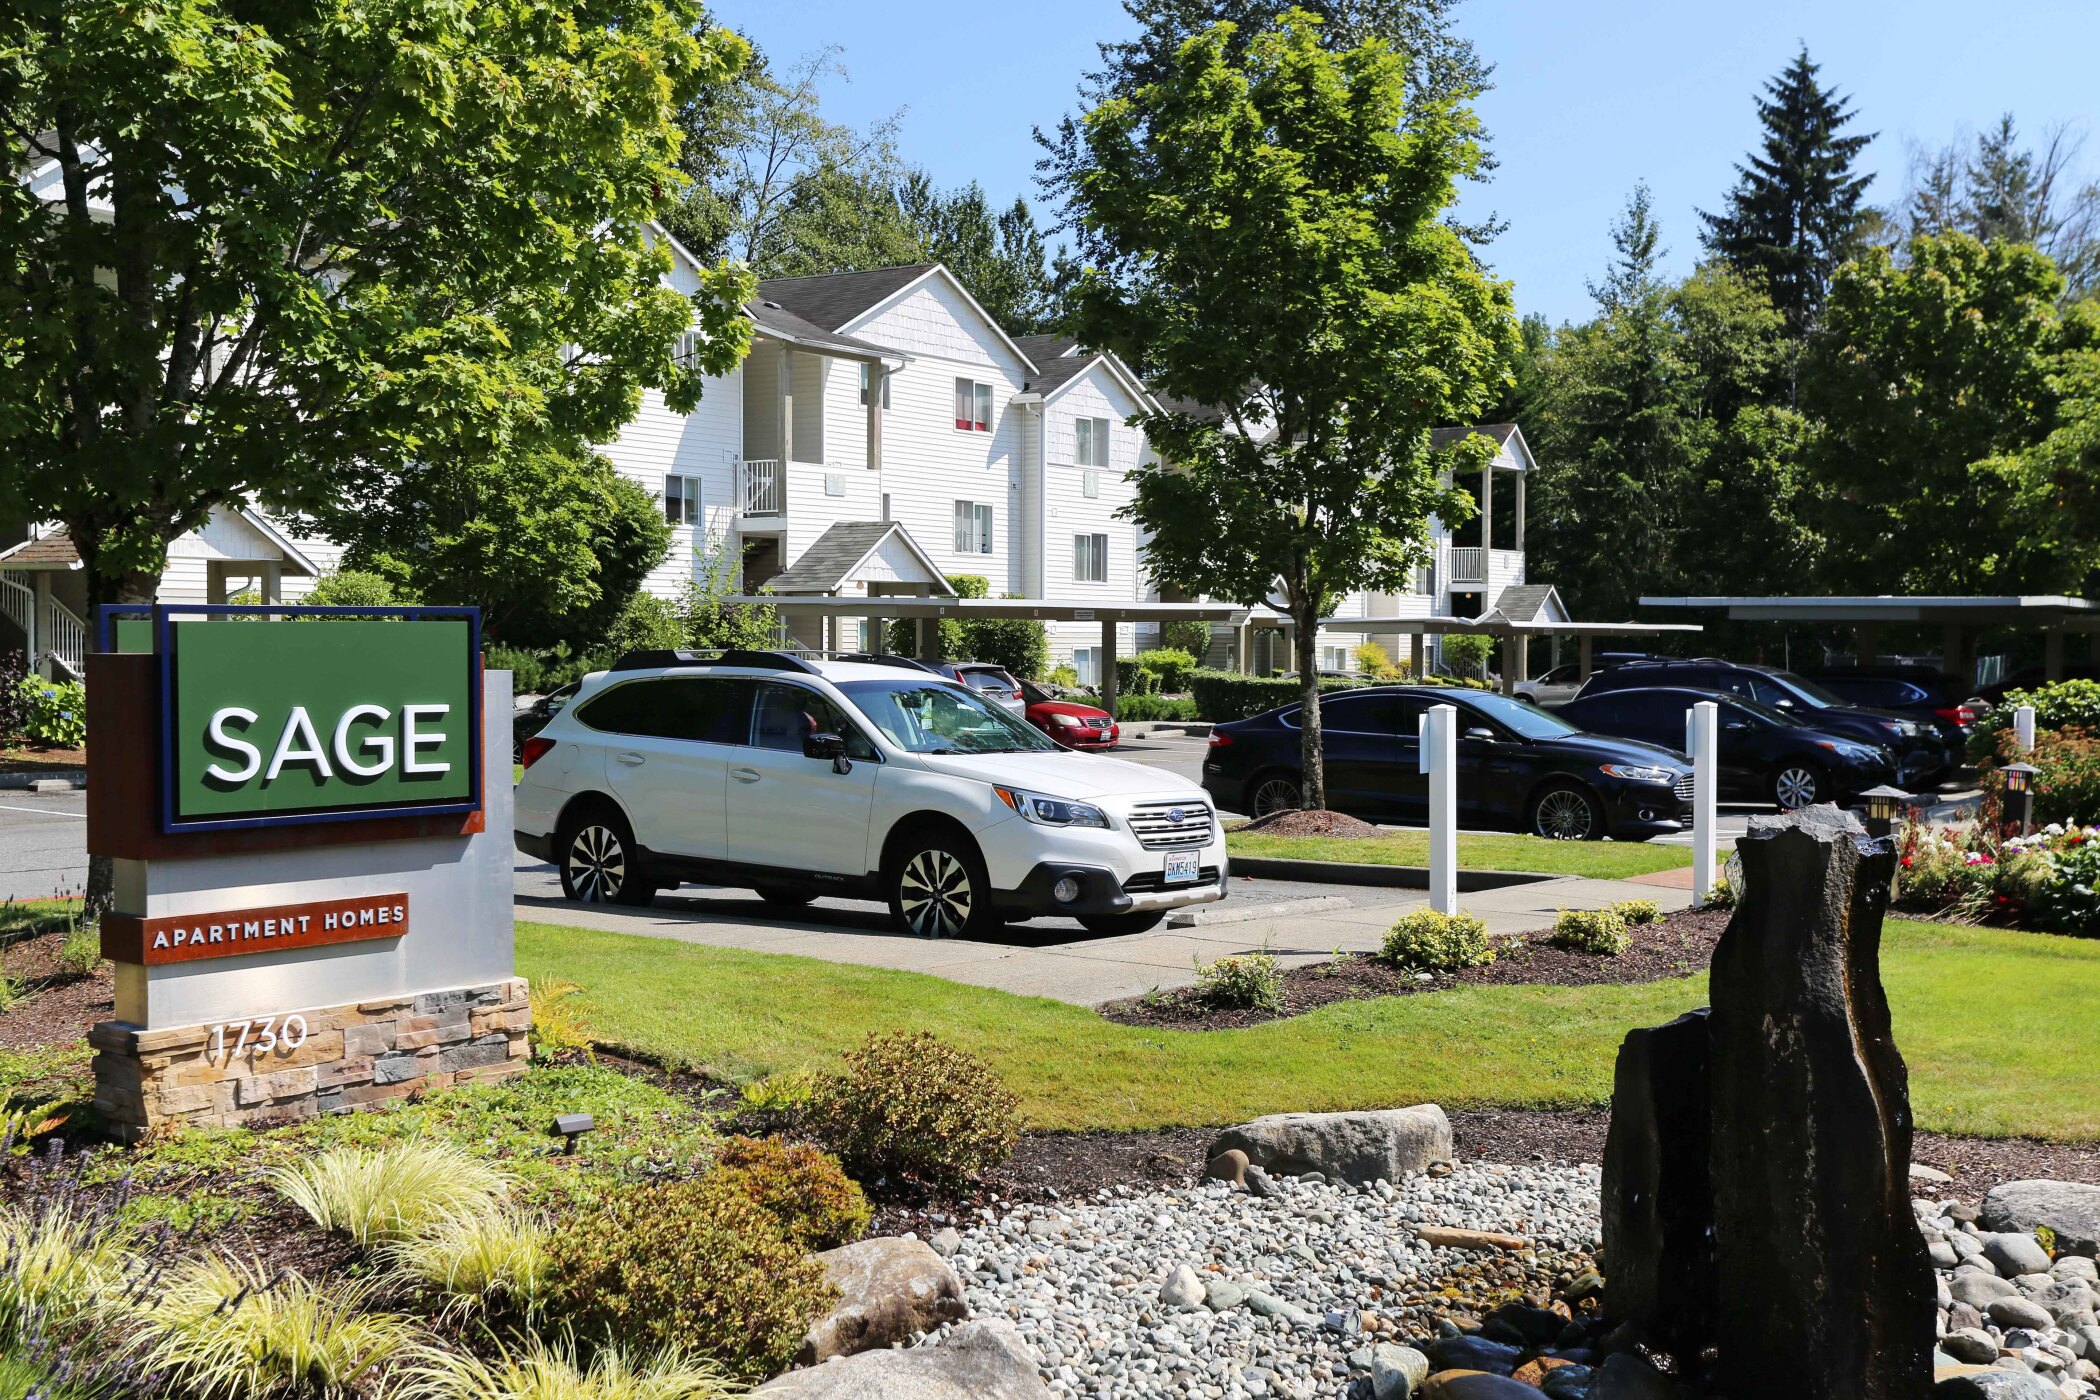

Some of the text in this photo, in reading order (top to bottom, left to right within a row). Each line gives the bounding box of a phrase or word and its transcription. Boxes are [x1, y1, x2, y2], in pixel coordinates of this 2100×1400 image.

[206, 703, 451, 783] SAGE
[153, 905, 404, 948] APARTMENT HOMES
[211, 1014, 307, 1059] 1730
